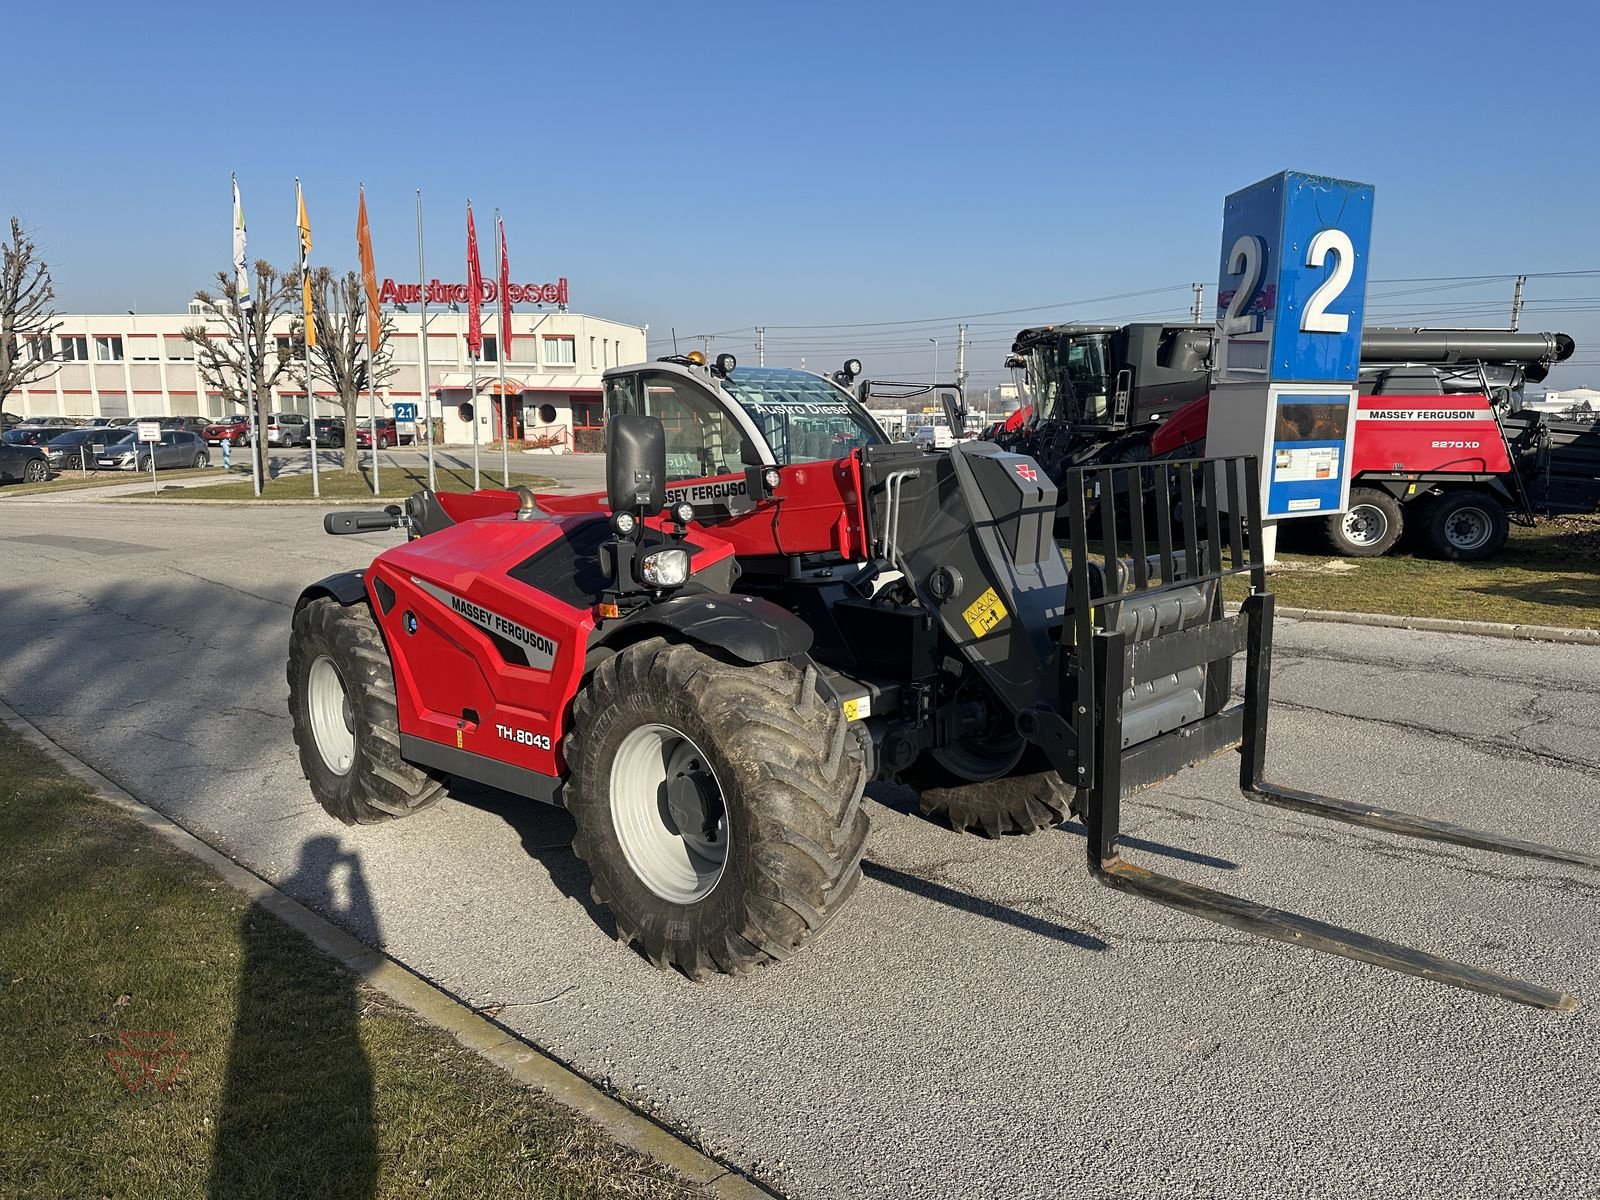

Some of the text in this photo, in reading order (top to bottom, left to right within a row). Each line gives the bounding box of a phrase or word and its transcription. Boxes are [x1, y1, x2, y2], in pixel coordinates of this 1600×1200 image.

[480, 277, 569, 304] Desel
[1223, 235, 1263, 336] 2
[1300, 229, 1355, 333] 2
[397, 406, 413, 419] 2.1
[753, 402, 853, 415] Austro Diesel
[1369, 411, 1475, 419] MASSEY FERGUSON
[1431, 441, 1480, 449] 2270XD
[664, 481, 748, 504] SEY FERGUSO
[451, 596, 553, 656] MASSEY FERGUSON
[495, 724, 551, 751] TH.8043
